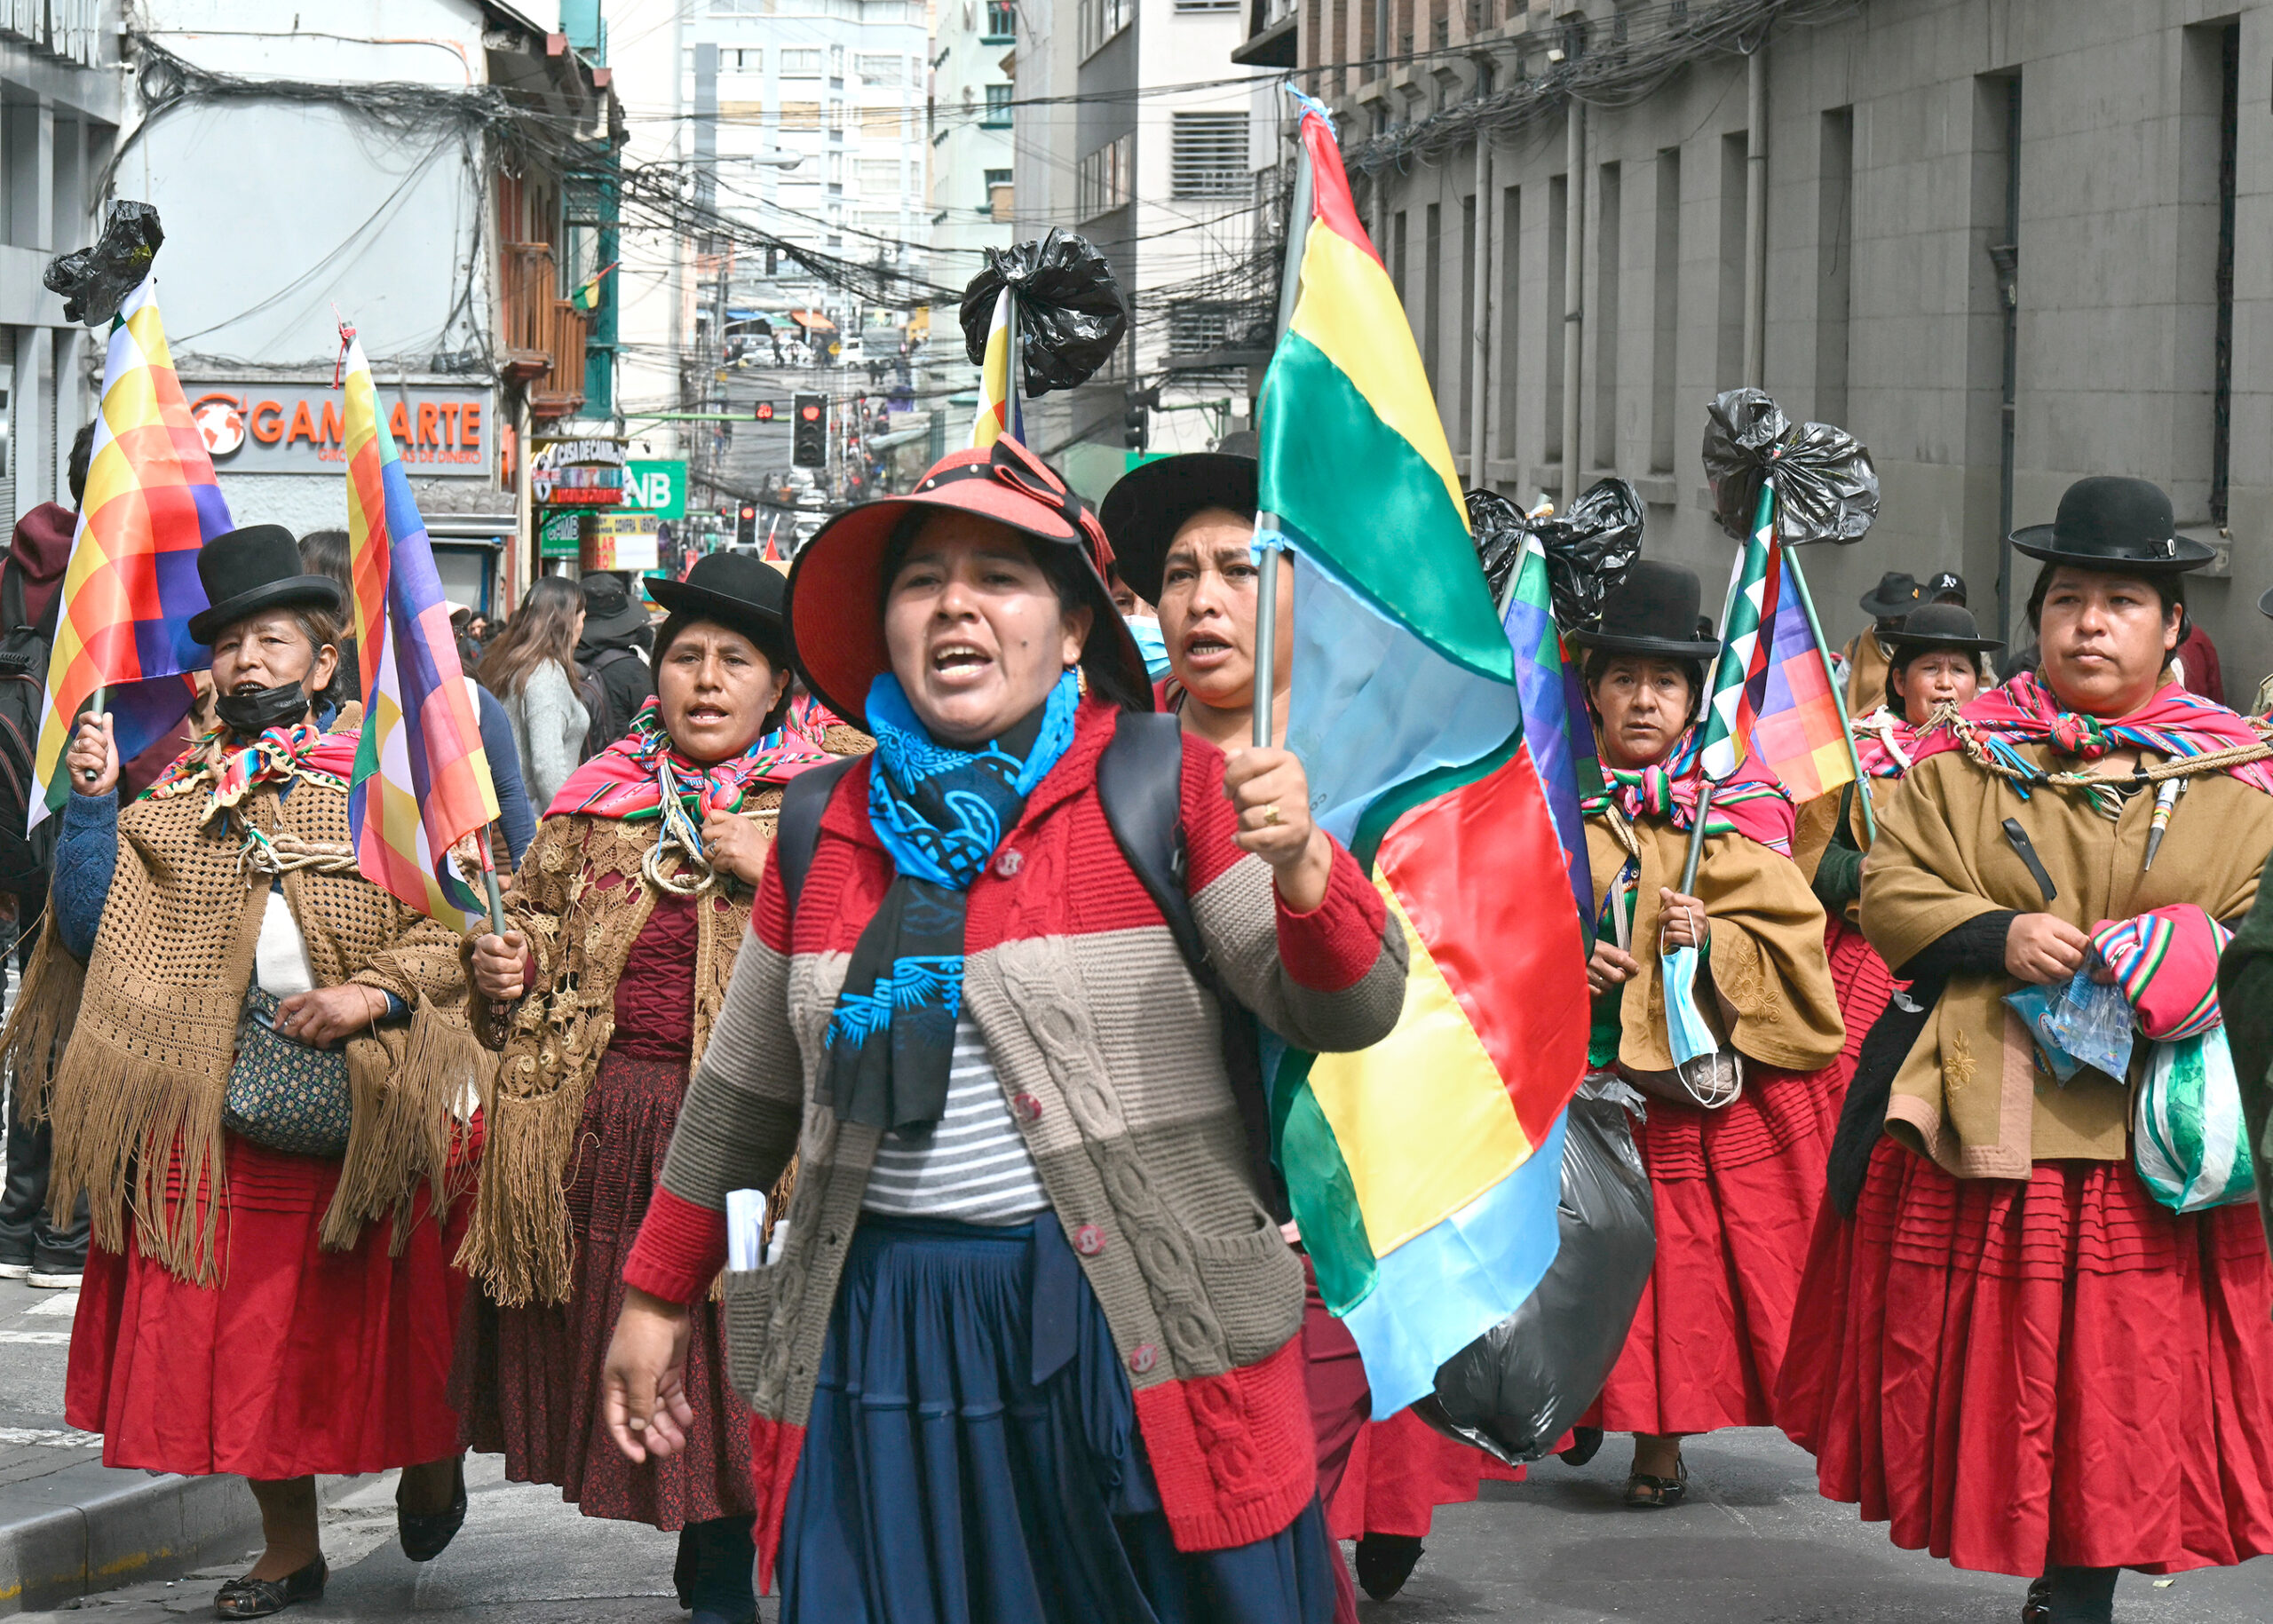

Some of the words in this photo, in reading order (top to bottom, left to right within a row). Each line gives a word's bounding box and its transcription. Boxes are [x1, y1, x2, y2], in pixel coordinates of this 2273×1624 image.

[251, 400, 481, 447] GAMARTE
[419, 449, 434, 463] DE
[438, 449, 482, 464] DINERO
[557, 441, 579, 466] CASA
[579, 440, 590, 461] DE
